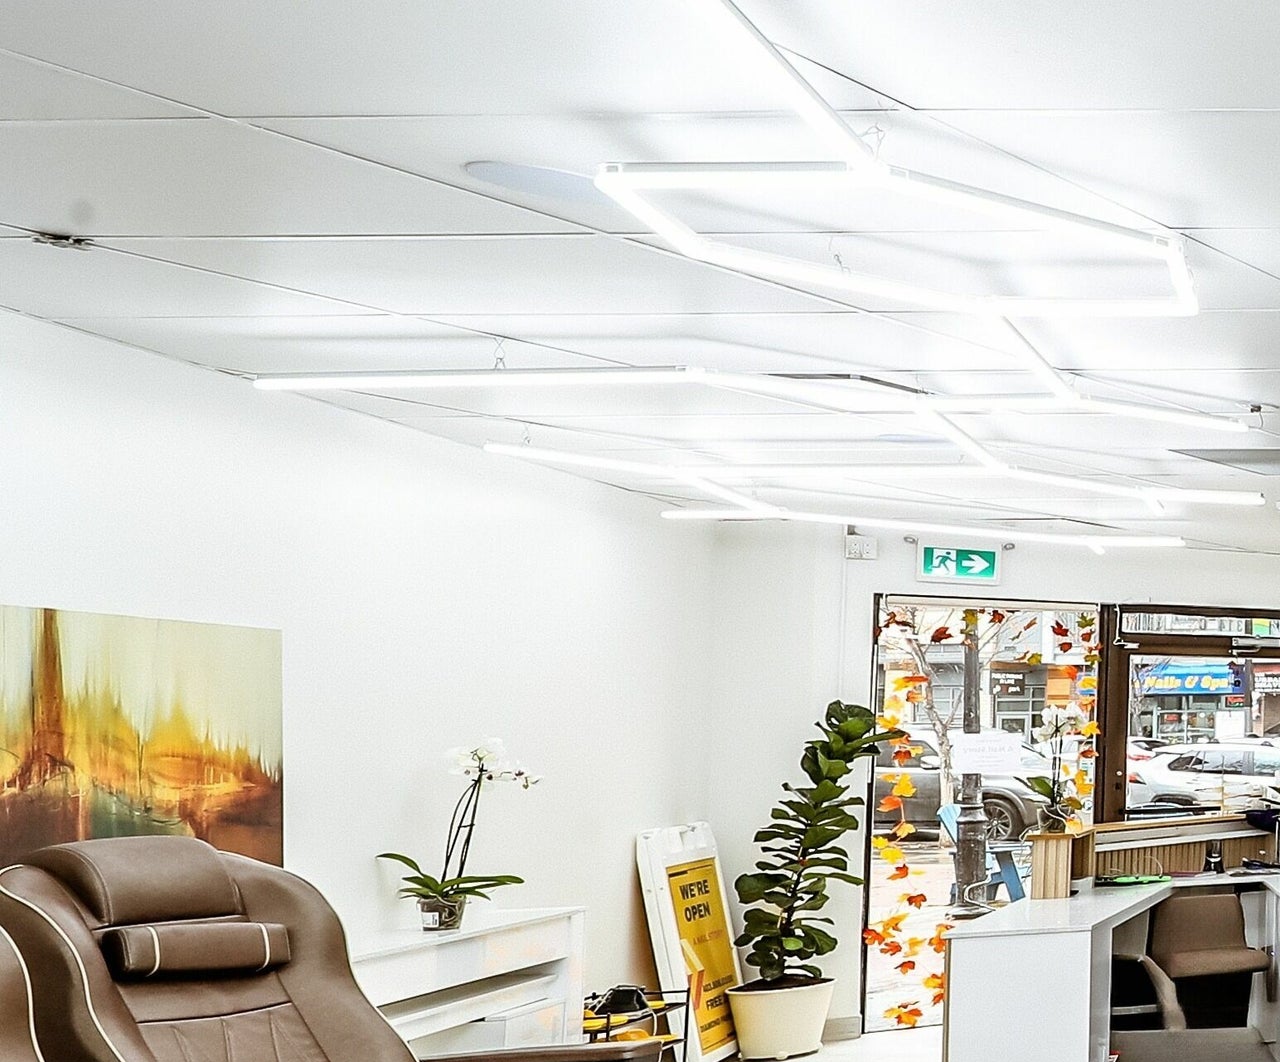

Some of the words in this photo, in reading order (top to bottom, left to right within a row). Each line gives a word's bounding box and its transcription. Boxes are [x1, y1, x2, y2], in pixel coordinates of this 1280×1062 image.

[679, 879, 710, 900] WE'RE
[684, 901, 711, 922] OPEN
[705, 995, 723, 1011] FREE
